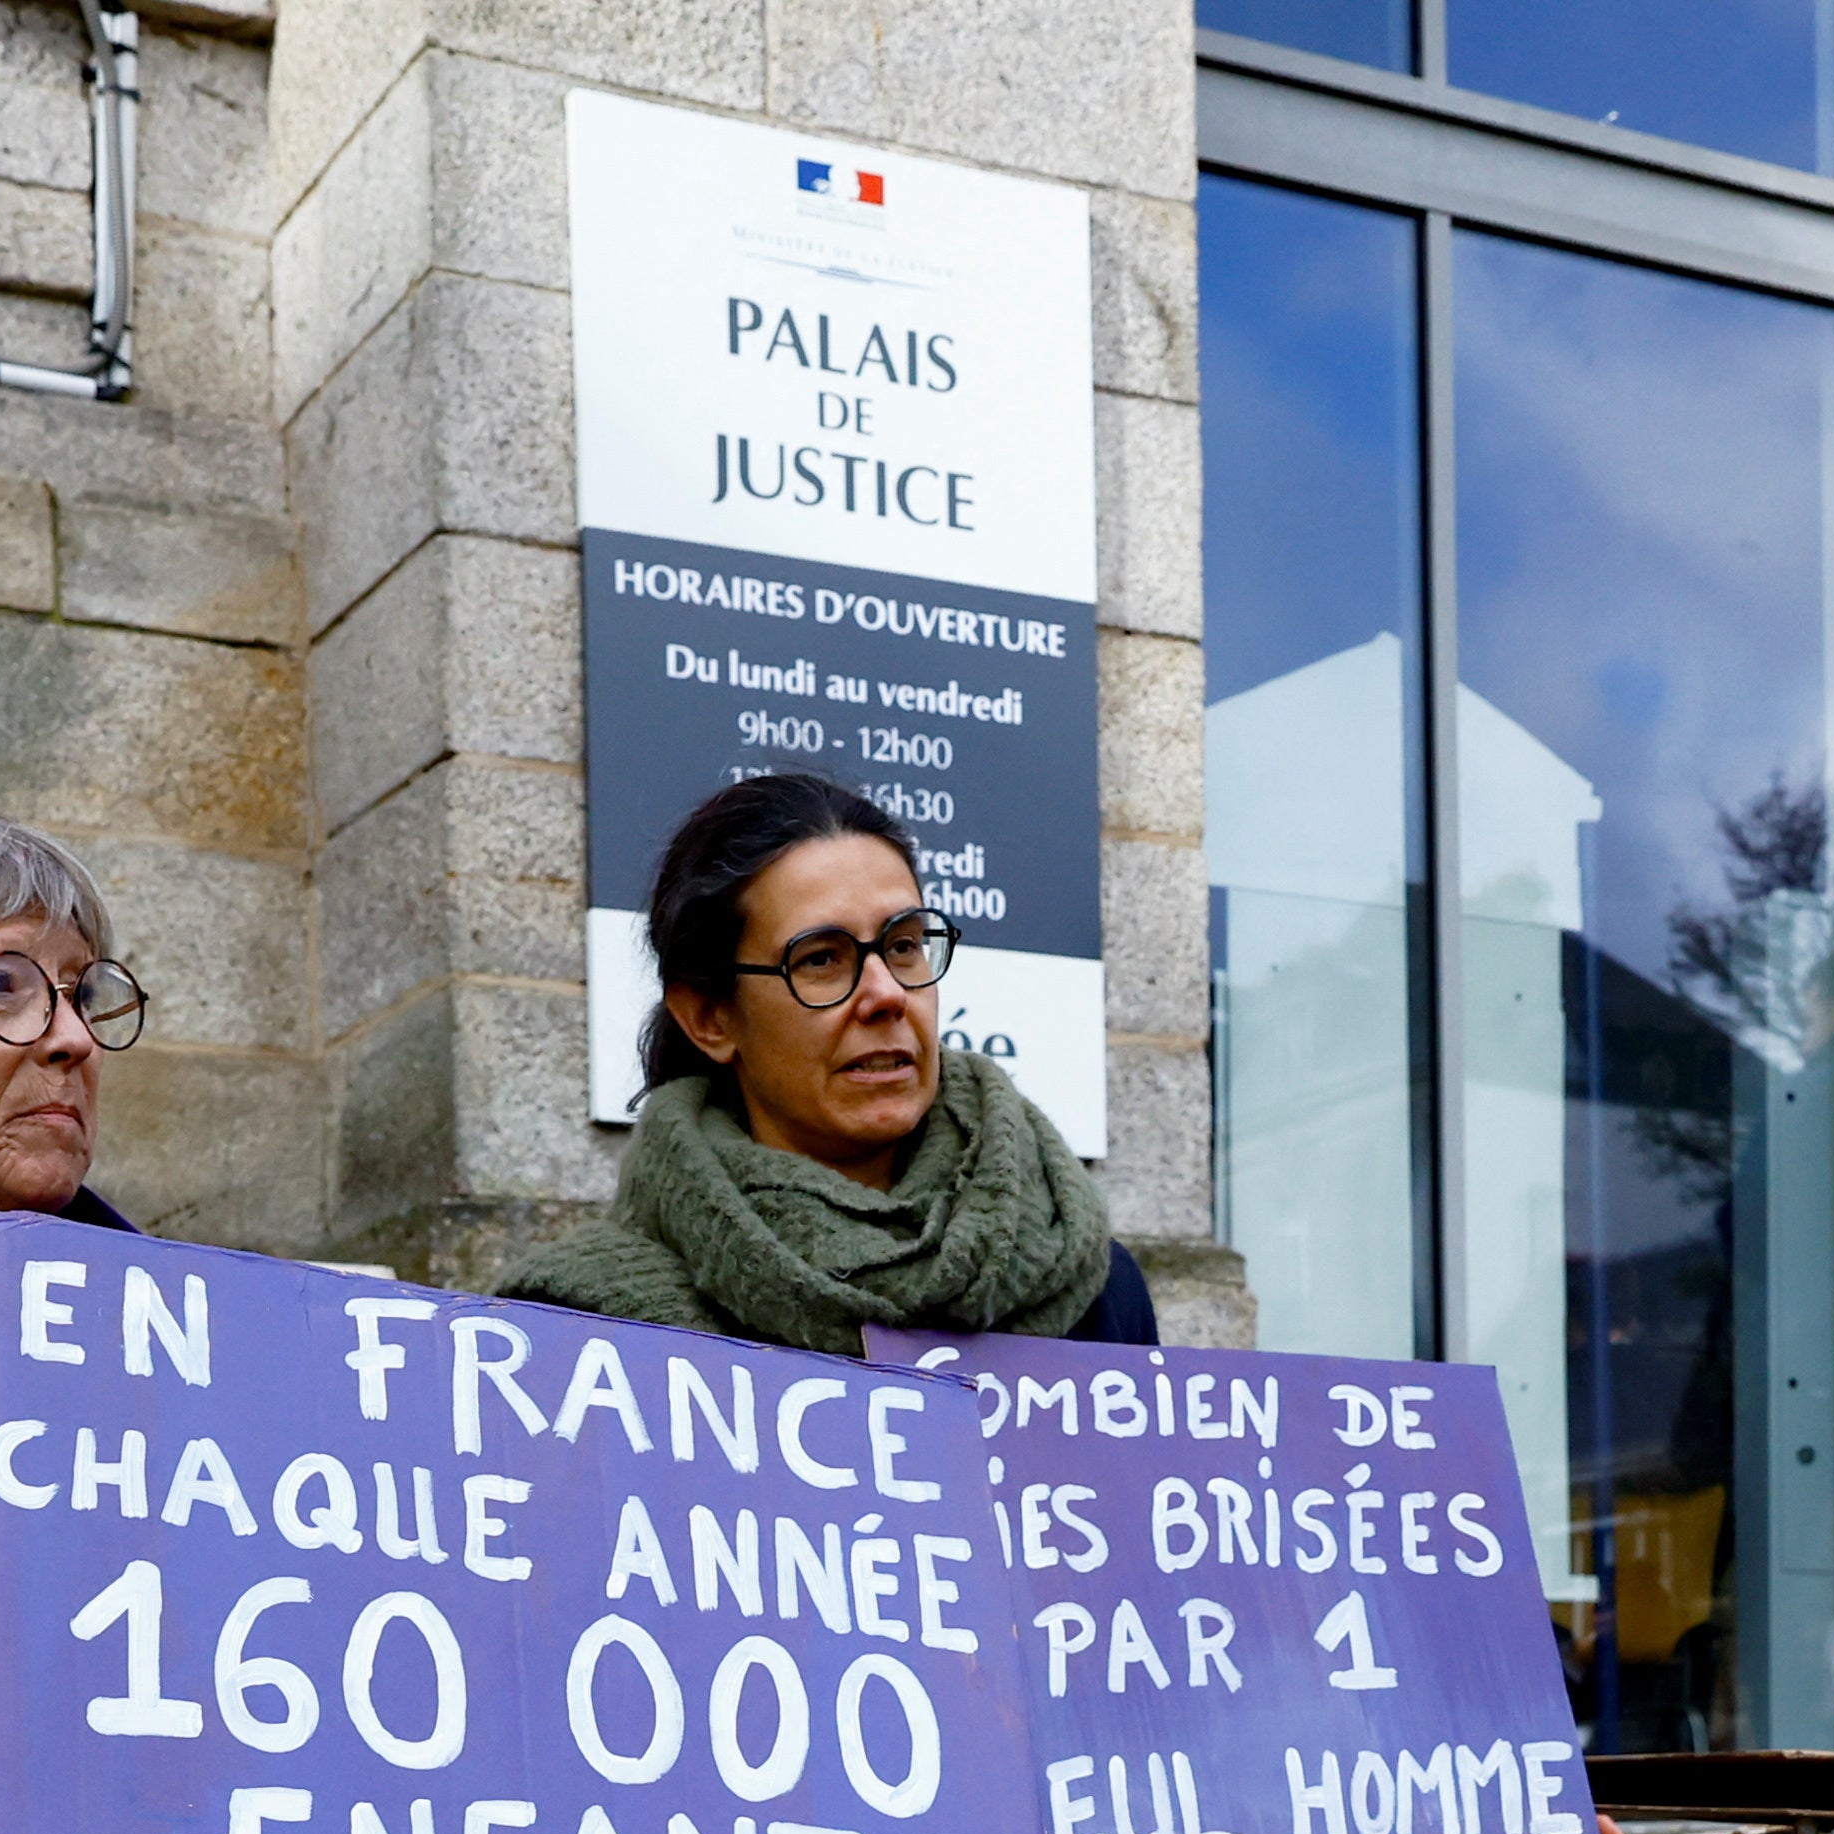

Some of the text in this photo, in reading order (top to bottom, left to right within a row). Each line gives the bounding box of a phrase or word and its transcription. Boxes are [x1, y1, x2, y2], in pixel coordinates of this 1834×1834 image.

[727, 297, 957, 393] PALAIS
[819, 391, 873, 436] DE
[712, 434, 975, 531] JUSTICE
[614, 558, 1067, 658] HORAIRES D'OUVERTURE
[666, 643, 1024, 725] Du lundi au vendredi
[738, 710, 824, 753] 9h00
[858, 727, 954, 770] 12h00
[914, 837, 985, 879] redi
[923, 880, 1006, 921] 6h00
[20, 1259, 942, 1502] EN FRANCE
[1328, 1384, 1436, 1450] DE
[988, 1456, 1505, 1577] IES BRISÉES
[607, 1495, 979, 1654] ANNÉE
[69, 1559, 943, 1820] 160 000
[1034, 1590, 1399, 1698] PAR 1
